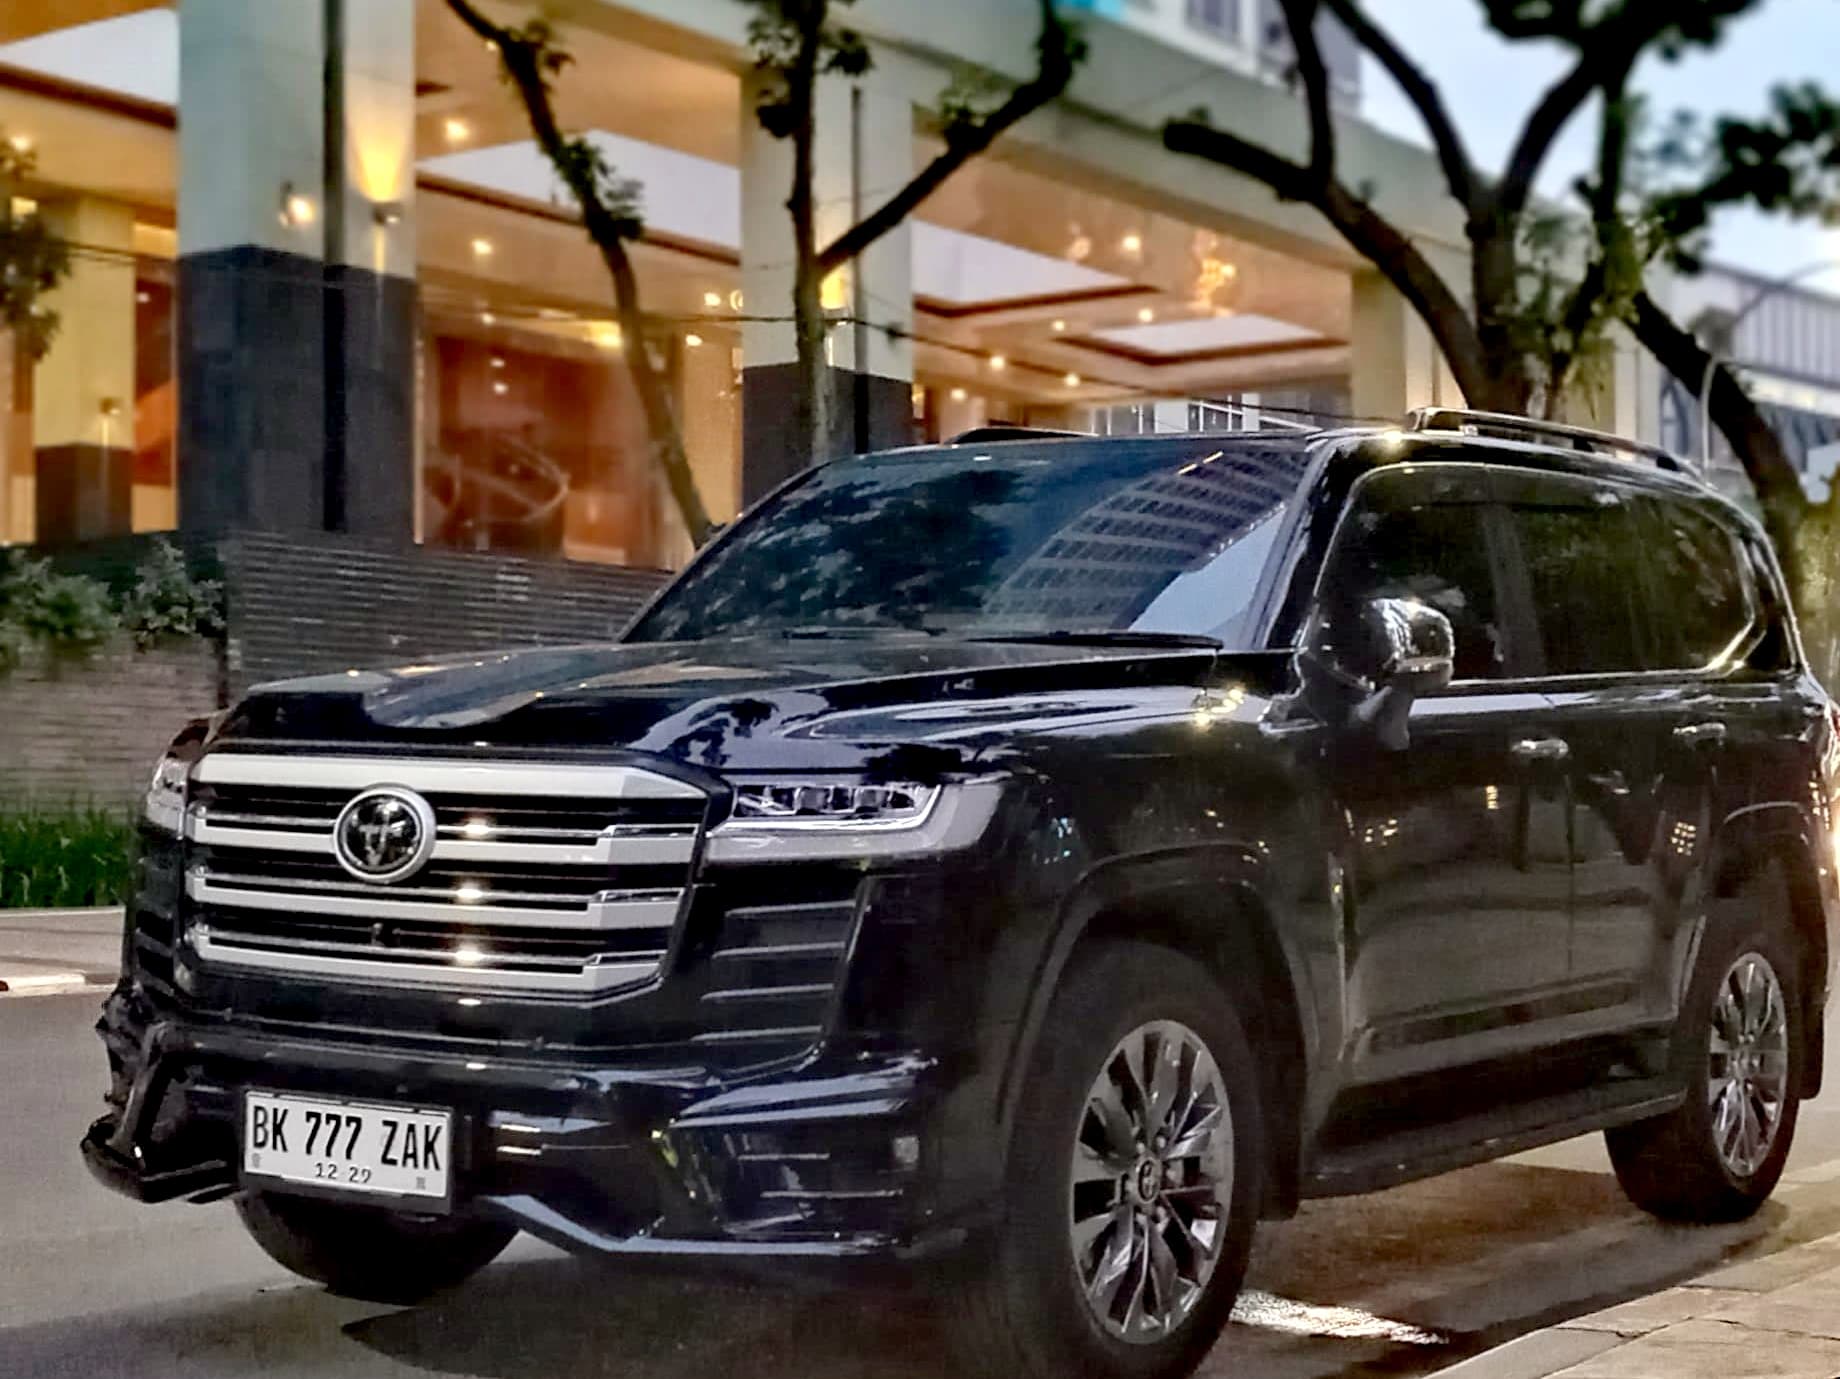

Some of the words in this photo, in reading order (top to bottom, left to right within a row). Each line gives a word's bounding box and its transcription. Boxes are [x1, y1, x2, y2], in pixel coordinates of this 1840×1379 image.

[253, 1105, 289, 1152] BK
[305, 1111, 362, 1160] 777
[380, 1119, 442, 1171] ZAK
